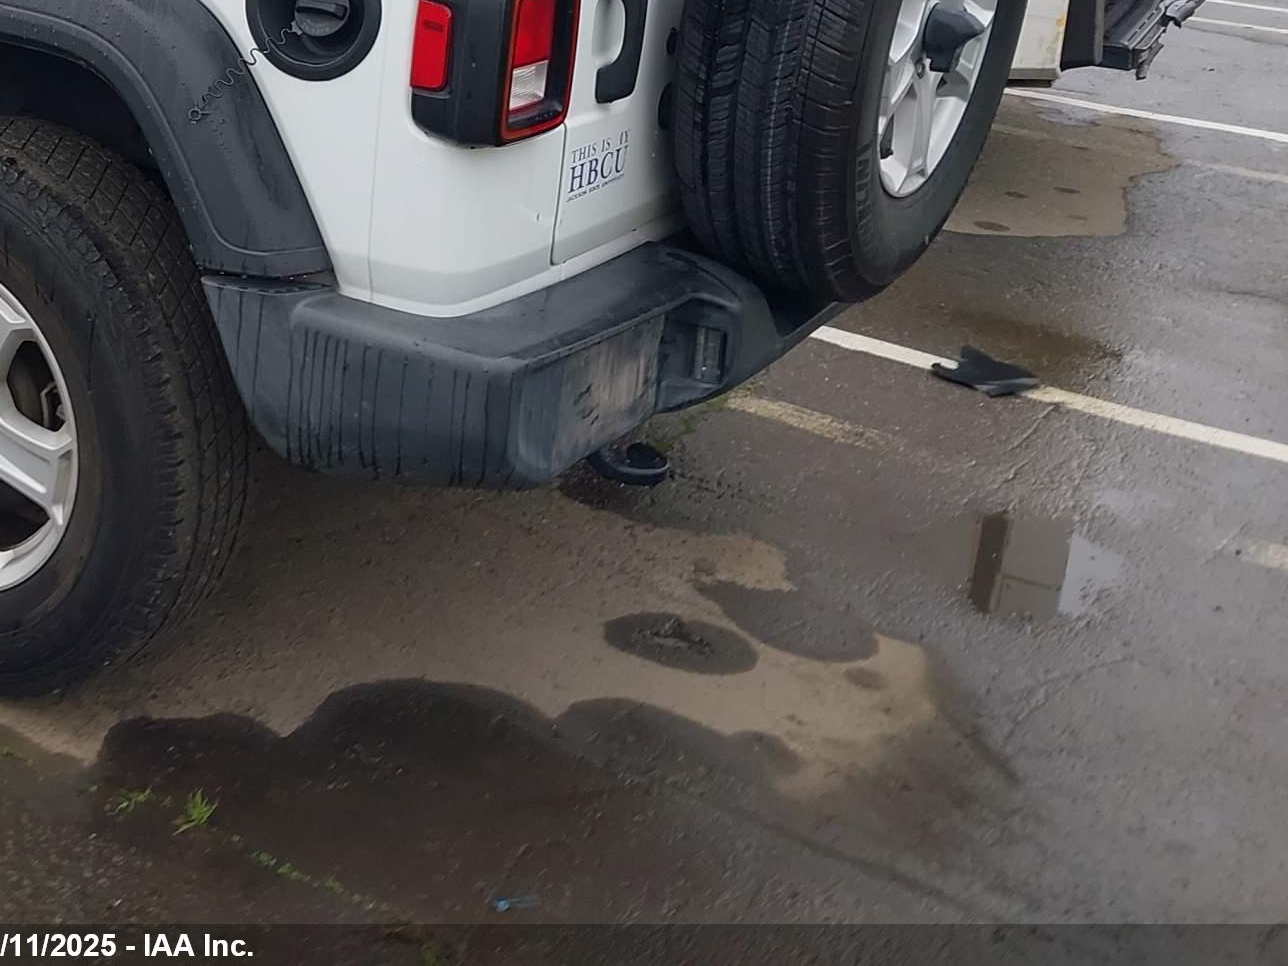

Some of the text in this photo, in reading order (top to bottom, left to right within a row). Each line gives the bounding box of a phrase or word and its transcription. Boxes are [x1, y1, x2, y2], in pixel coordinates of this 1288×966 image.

[567, 145, 629, 194] HBCU
[571, 143, 597, 164] THIS
[600, 137, 611, 153] IS
